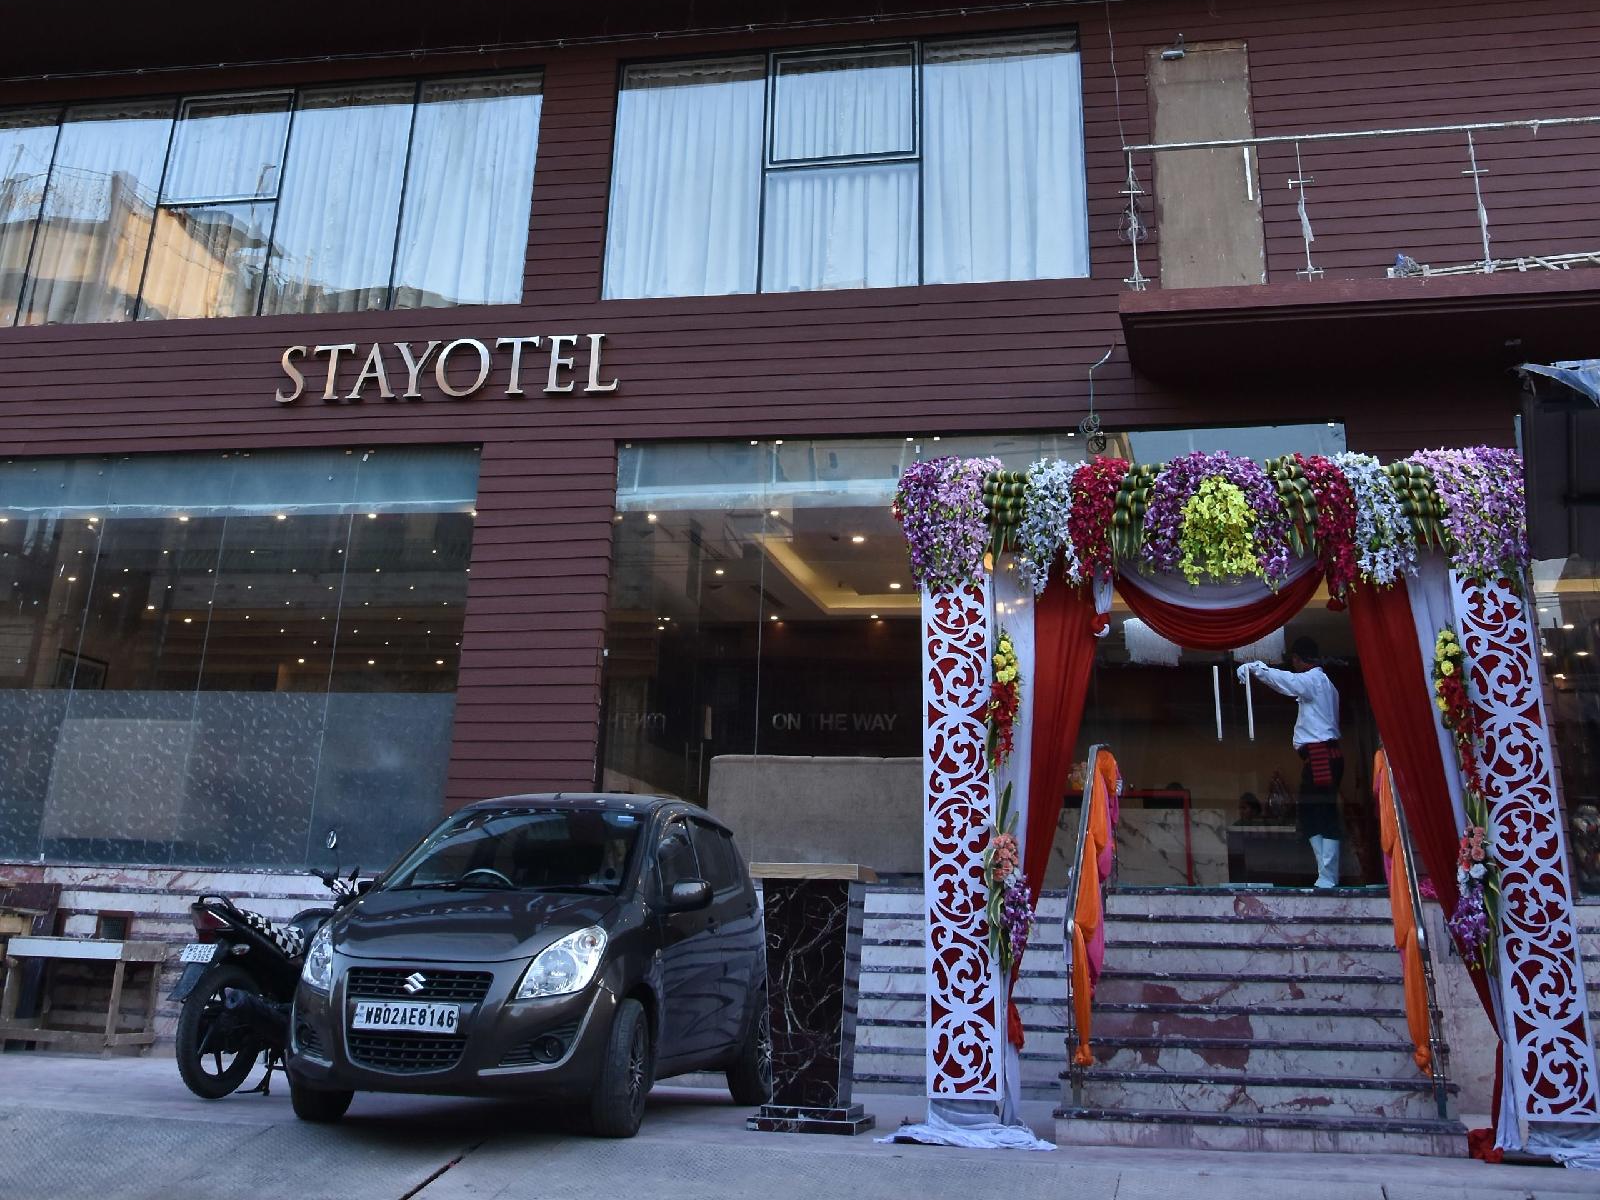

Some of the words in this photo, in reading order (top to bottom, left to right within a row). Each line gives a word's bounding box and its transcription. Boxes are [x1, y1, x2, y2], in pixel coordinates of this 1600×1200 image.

[275, 333, 620, 403] STAYOTEL
[771, 713, 801, 731] ON
[851, 713, 897, 731] WAY
[364, 1006, 455, 1028] WB02AE8146
